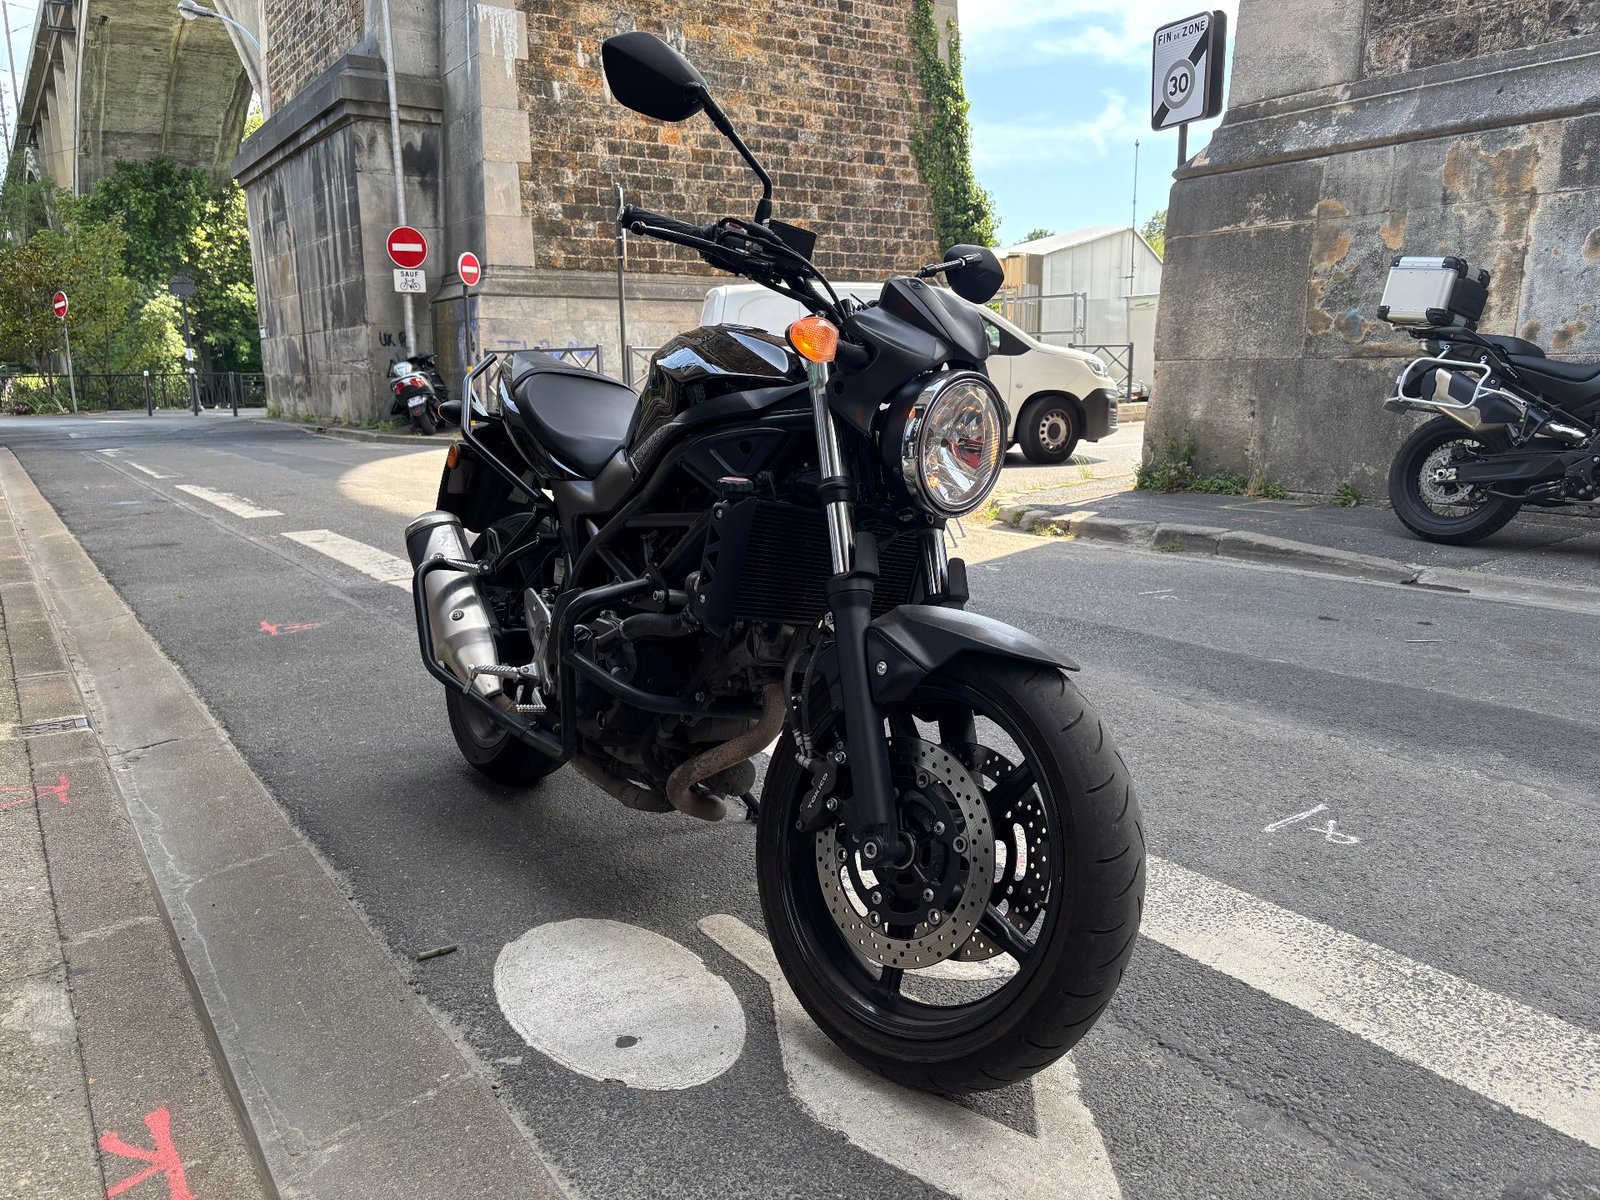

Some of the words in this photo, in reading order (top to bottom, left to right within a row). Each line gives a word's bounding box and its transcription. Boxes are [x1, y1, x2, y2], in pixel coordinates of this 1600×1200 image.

[1157, 32, 1172, 45] FIN
[1182, 20, 1206, 37] ZONE
[1169, 72, 1189, 96] 30
[807, 773, 828, 808] TOKICO
